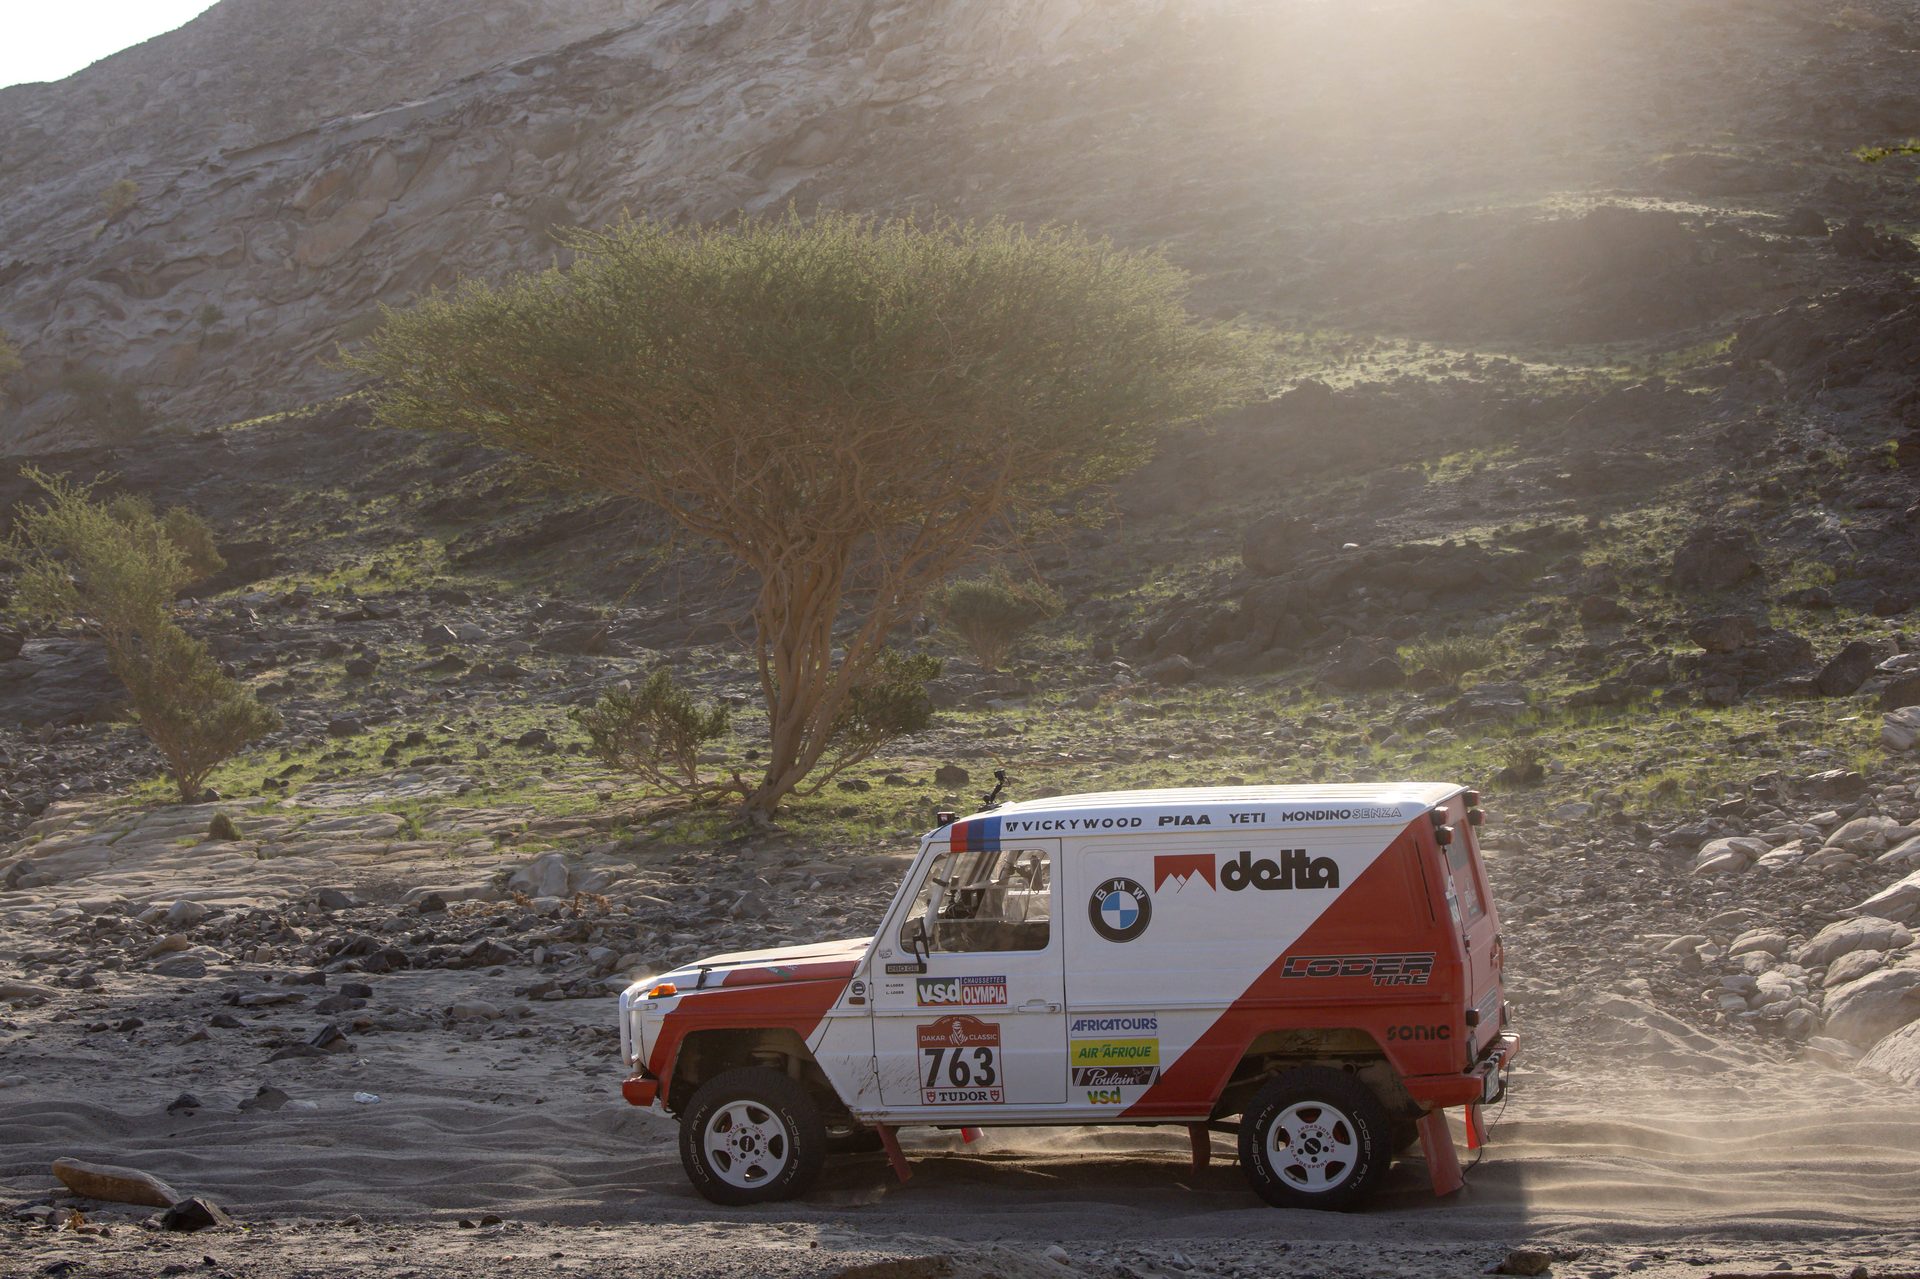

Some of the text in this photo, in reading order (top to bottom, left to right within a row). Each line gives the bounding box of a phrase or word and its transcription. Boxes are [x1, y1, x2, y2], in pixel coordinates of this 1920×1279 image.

[1022, 817, 1143, 832] VICKYWOOD
[1158, 814, 1212, 827] PIAA
[1229, 812, 1266, 824] YETI
[1220, 849, 1340, 892] delta
[1280, 952, 1436, 979] LODER
[963, 976, 1005, 984] CHAUSSETTES
[1372, 975, 1430, 987] TIRE
[919, 978, 961, 1003] vsd
[962, 985, 1007, 1004] OLYMPIA
[1071, 1018, 1158, 1031] AFRICATOURS
[921, 1033, 997, 1042] DAKAR CLASSIC
[1078, 1046, 1152, 1058] AIR AFRIQUE
[925, 1047, 996, 1087] 763
[1087, 1068, 1135, 1086] Poulain
[939, 1091, 988, 1102] TUDOR
[1087, 1086, 1121, 1104] vsd
